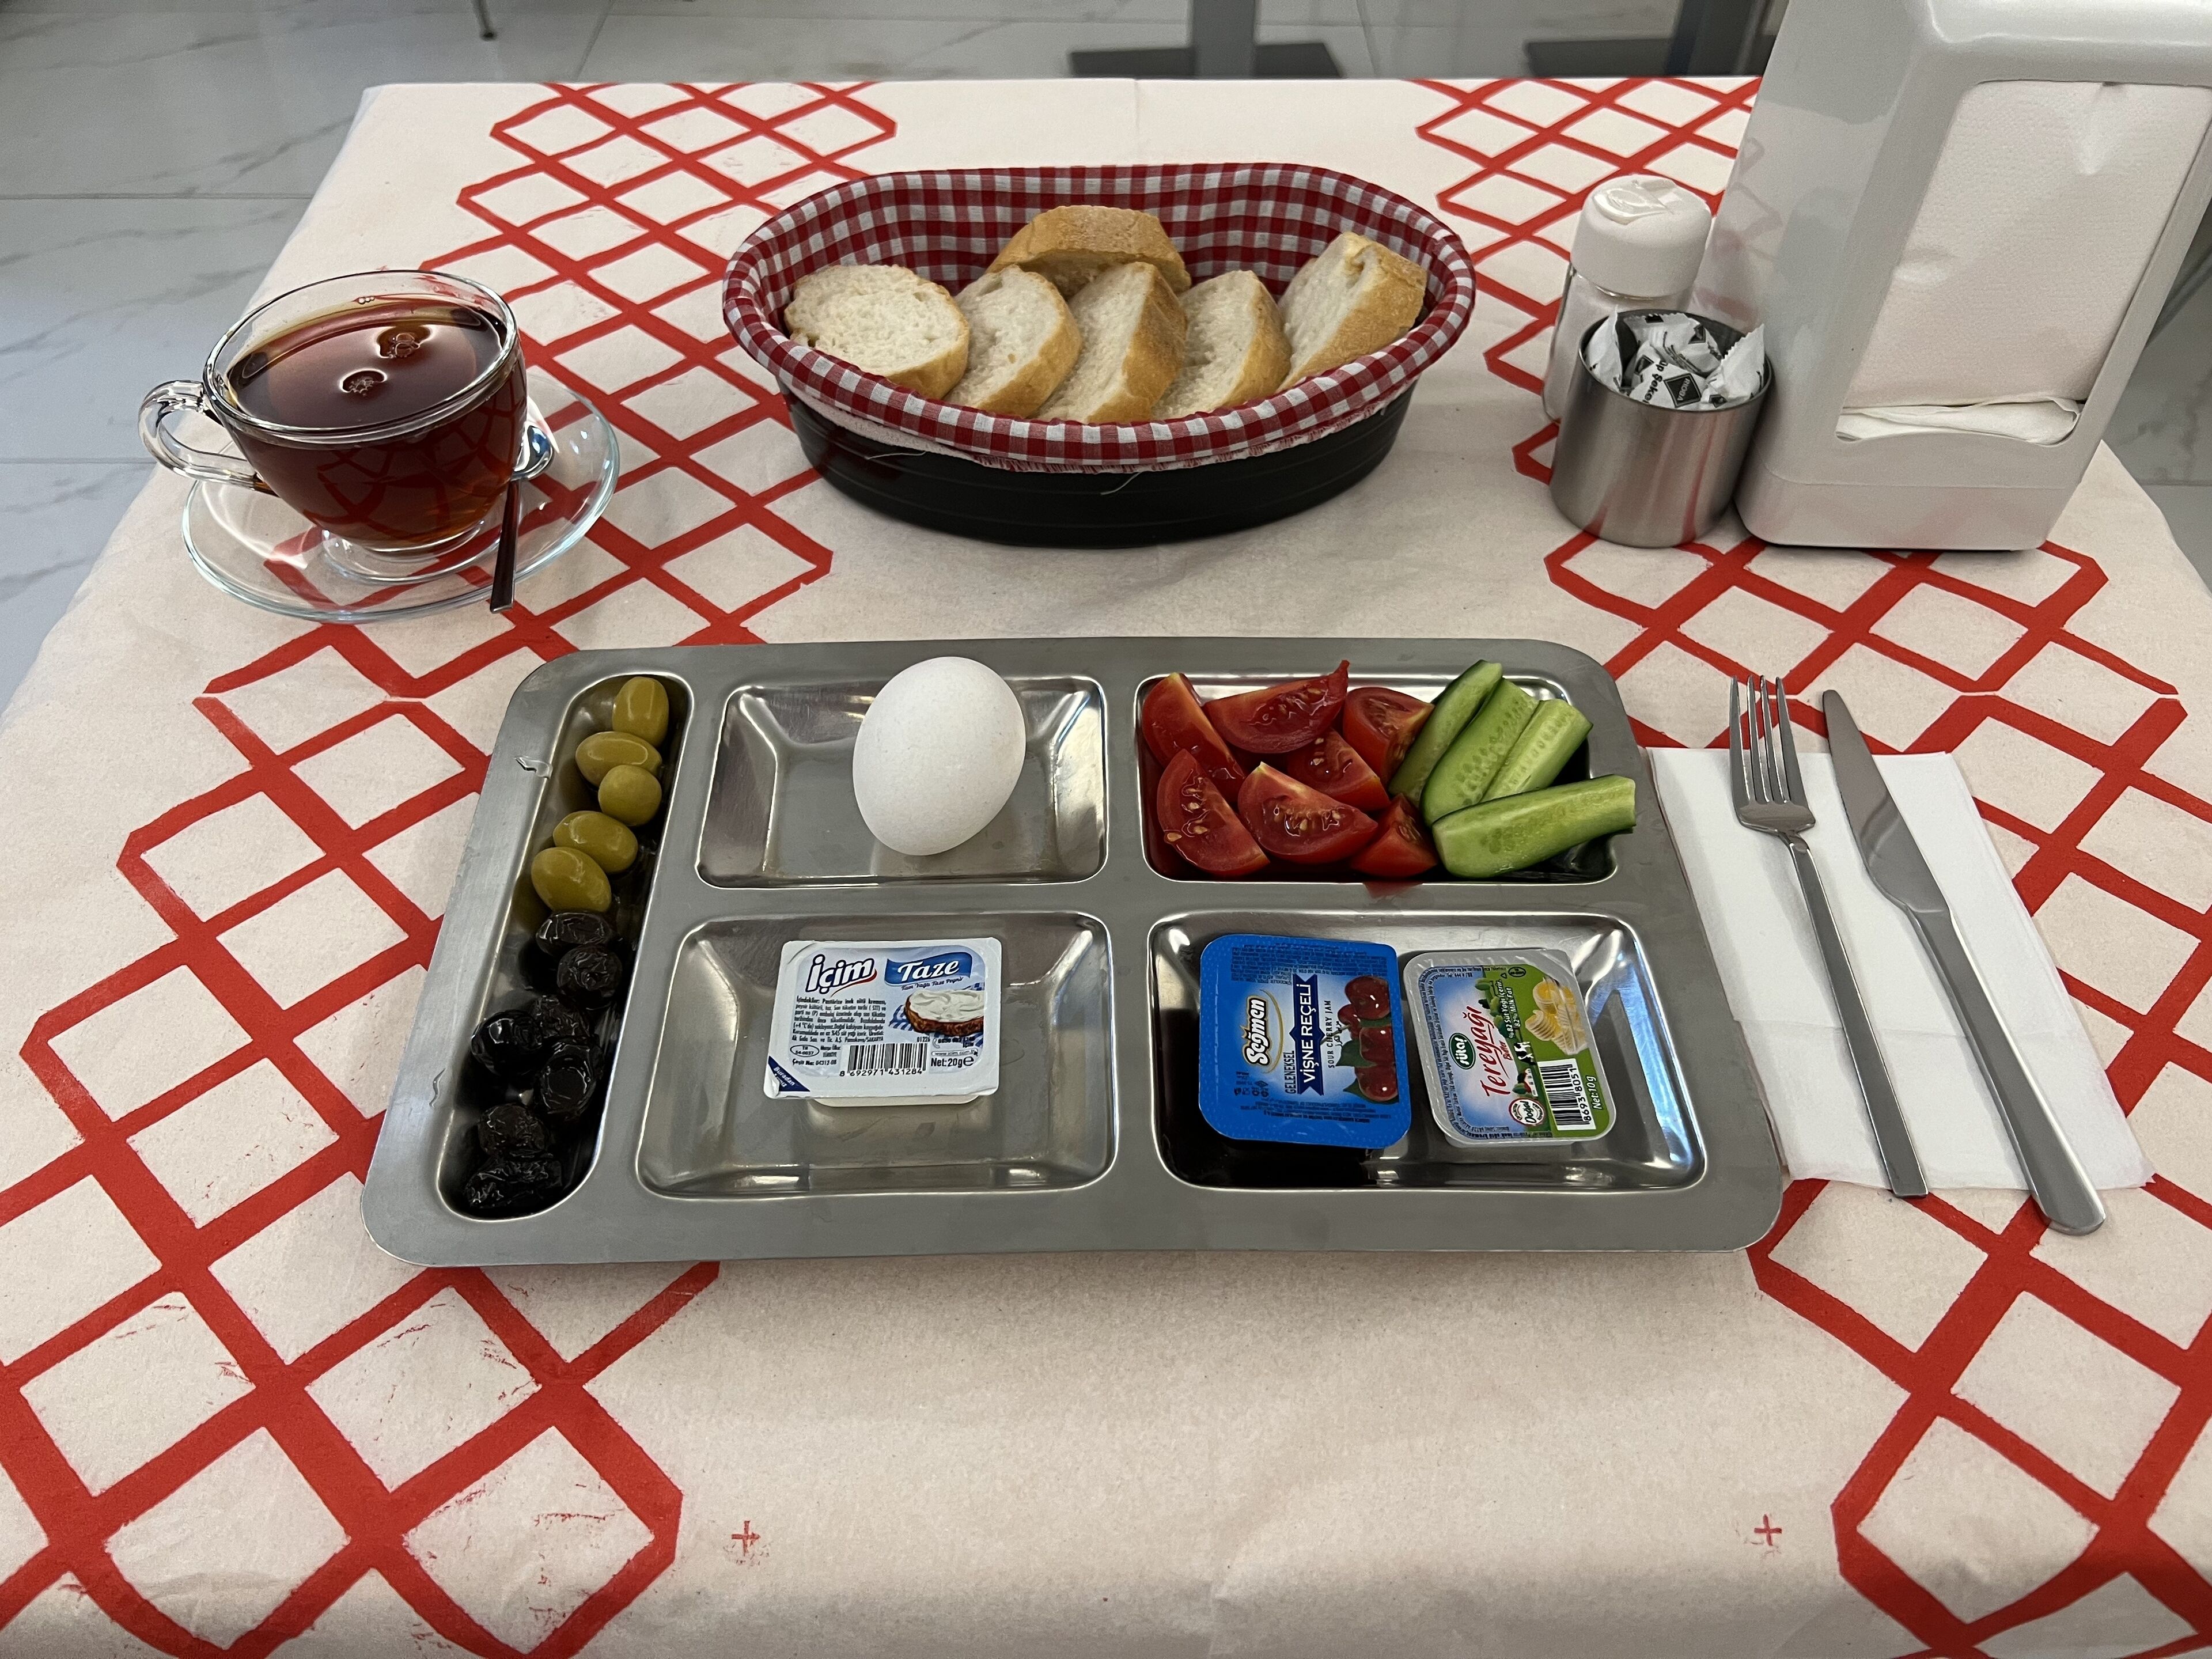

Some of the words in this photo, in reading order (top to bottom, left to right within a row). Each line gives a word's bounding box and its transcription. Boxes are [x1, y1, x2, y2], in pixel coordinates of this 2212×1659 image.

[1677, 378, 1690, 402] RIOBA
[805, 954, 874, 994] İçim
[897, 960, 960, 982] Taze
[1296, 984, 1317, 1037] REÇELİ
[1509, 998, 1518, 1012] Milk
[1300, 1039, 1319, 1084] VİŞNE
[1327, 1048, 1335, 1069] SOUR
[1453, 1037, 1469, 1066] sütaş
[1462, 1005, 1511, 1097] Tereyağı
[773, 1066, 796, 1086] Buradan
[1283, 1051, 1297, 1094] GELENEKSEL
[1519, 1101, 1537, 1123] Doğal
